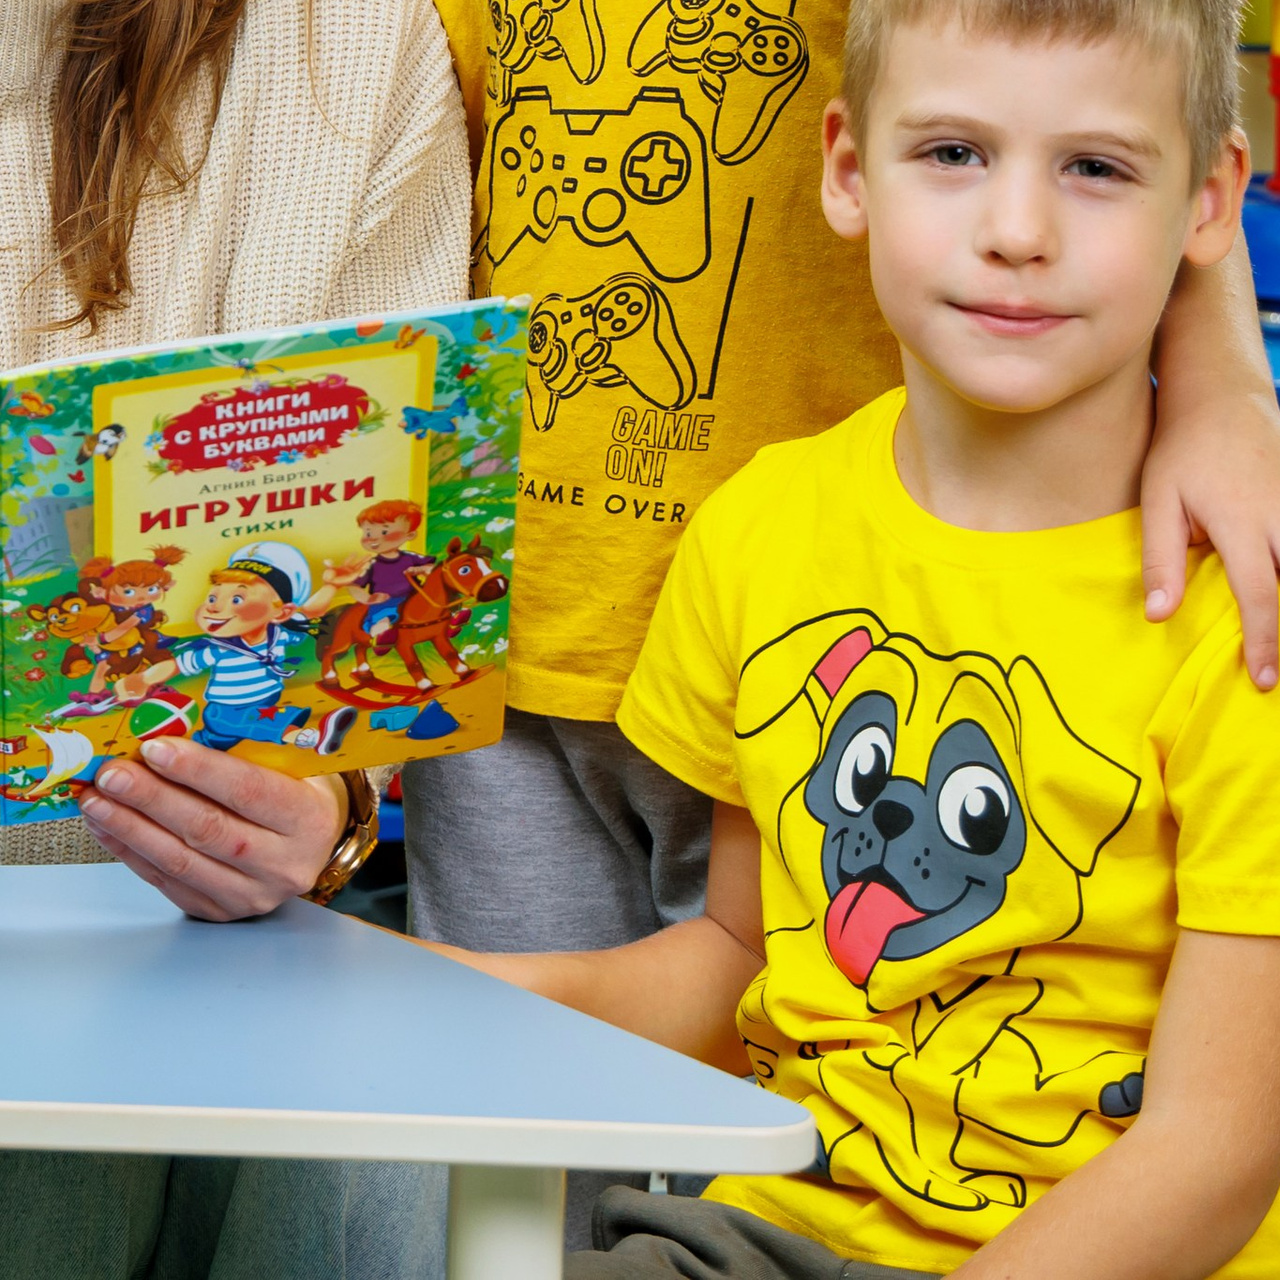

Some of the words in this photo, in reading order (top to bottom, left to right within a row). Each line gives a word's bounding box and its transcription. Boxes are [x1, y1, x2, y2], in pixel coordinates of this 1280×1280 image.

[215, 391, 311, 420] КНИГИ
[174, 430, 192, 445] С
[199, 405, 349, 442] КРУПНЫМИ
[612, 405, 716, 452] GAME
[204, 427, 326, 459] БУКВАМИ
[605, 443, 668, 488] ON!
[198, 477, 257, 495] Агния
[262, 469, 318, 486] Барто
[140, 476, 376, 534] ИГРУШКИ
[605, 494, 686, 523] OVER
[221, 519, 294, 538] СТИХИ
